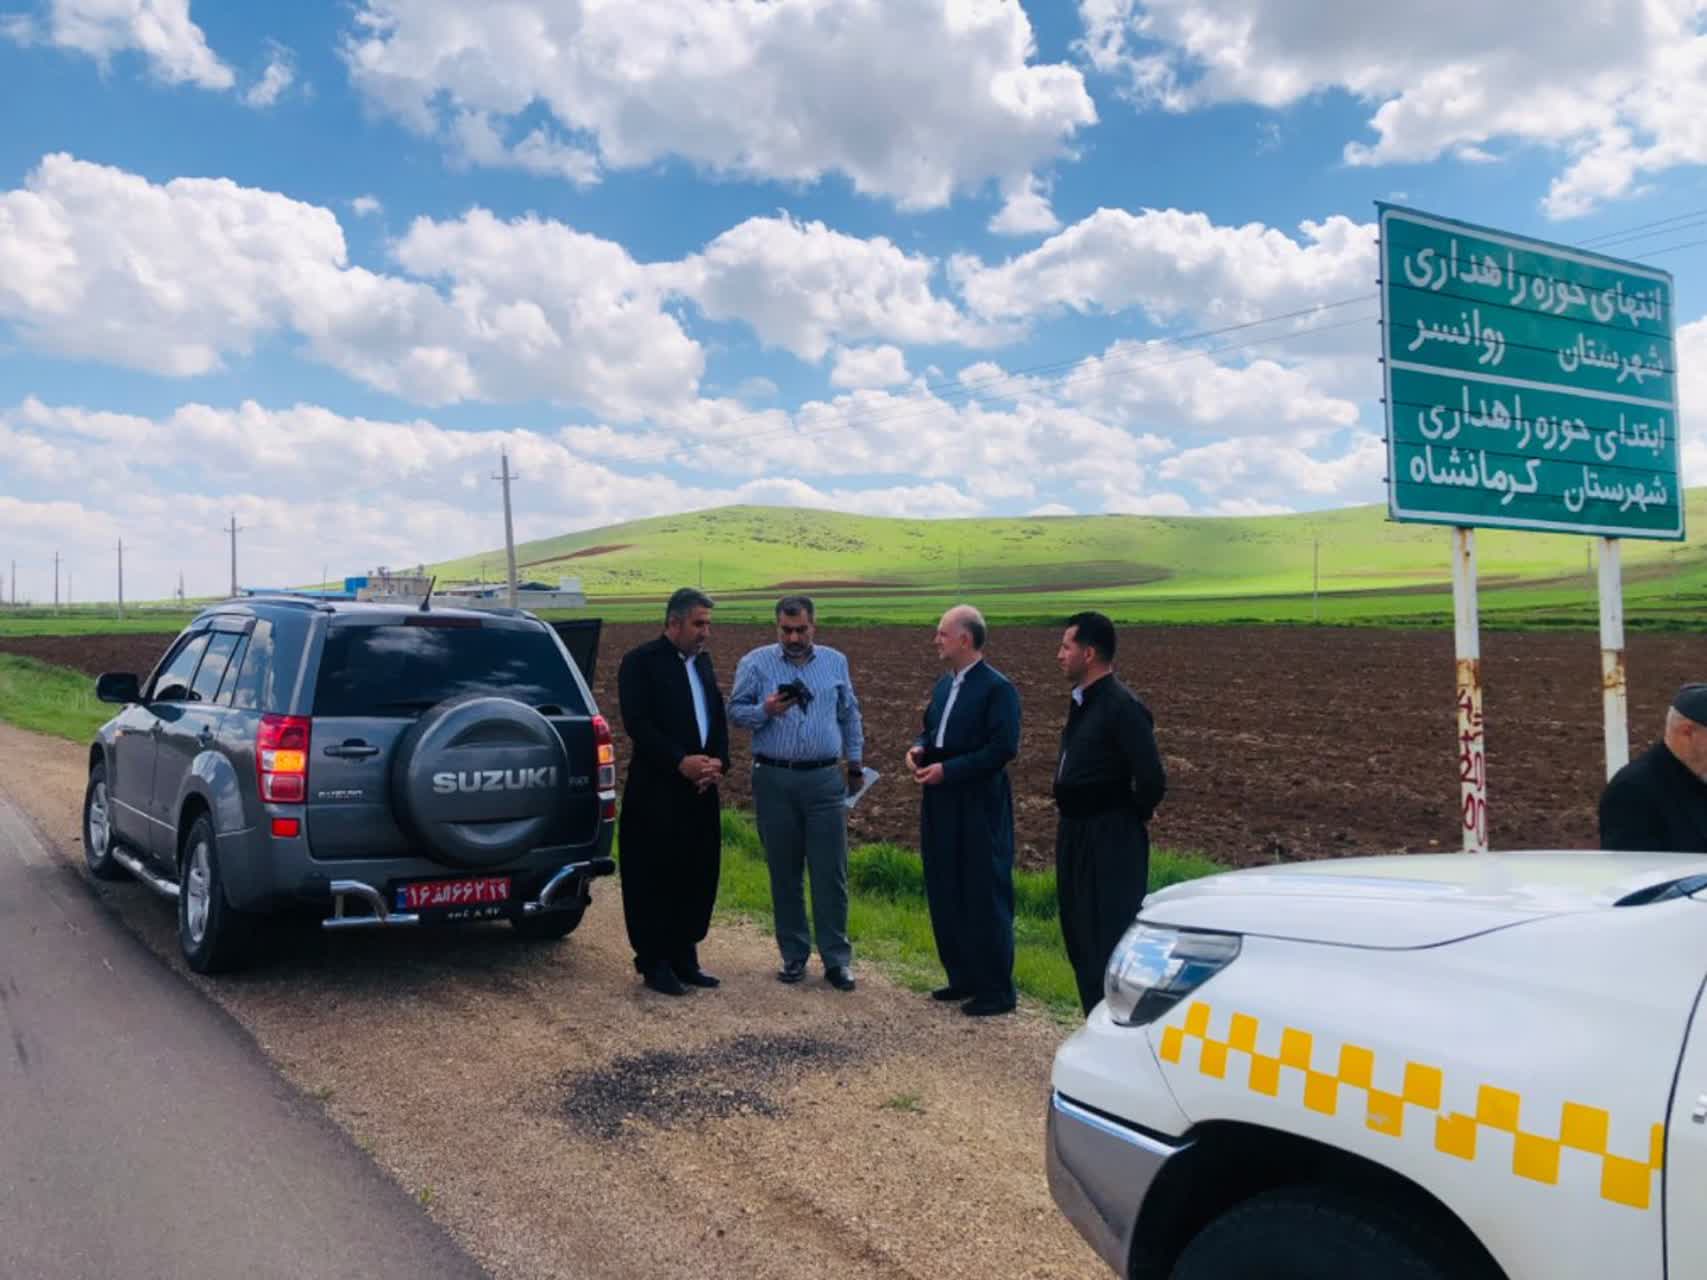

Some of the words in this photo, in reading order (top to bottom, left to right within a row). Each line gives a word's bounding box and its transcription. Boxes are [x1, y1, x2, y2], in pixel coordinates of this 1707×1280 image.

[1404, 239, 1527, 305] راهداری
[1533, 276, 1587, 314] حوزه
[1591, 281, 1662, 326] انتهای
[1408, 309, 1505, 365] روانسر
[1558, 333, 1664, 383] شهرستان
[1418, 385, 1531, 448] راهداری
[1535, 415, 1590, 451] حوزه
[1595, 413, 1665, 460] ابتدای
[1409, 445, 1540, 505] کرمانشاه
[1564, 465, 1667, 512] شهرستان
[432, 766, 558, 793] SUZUKI
